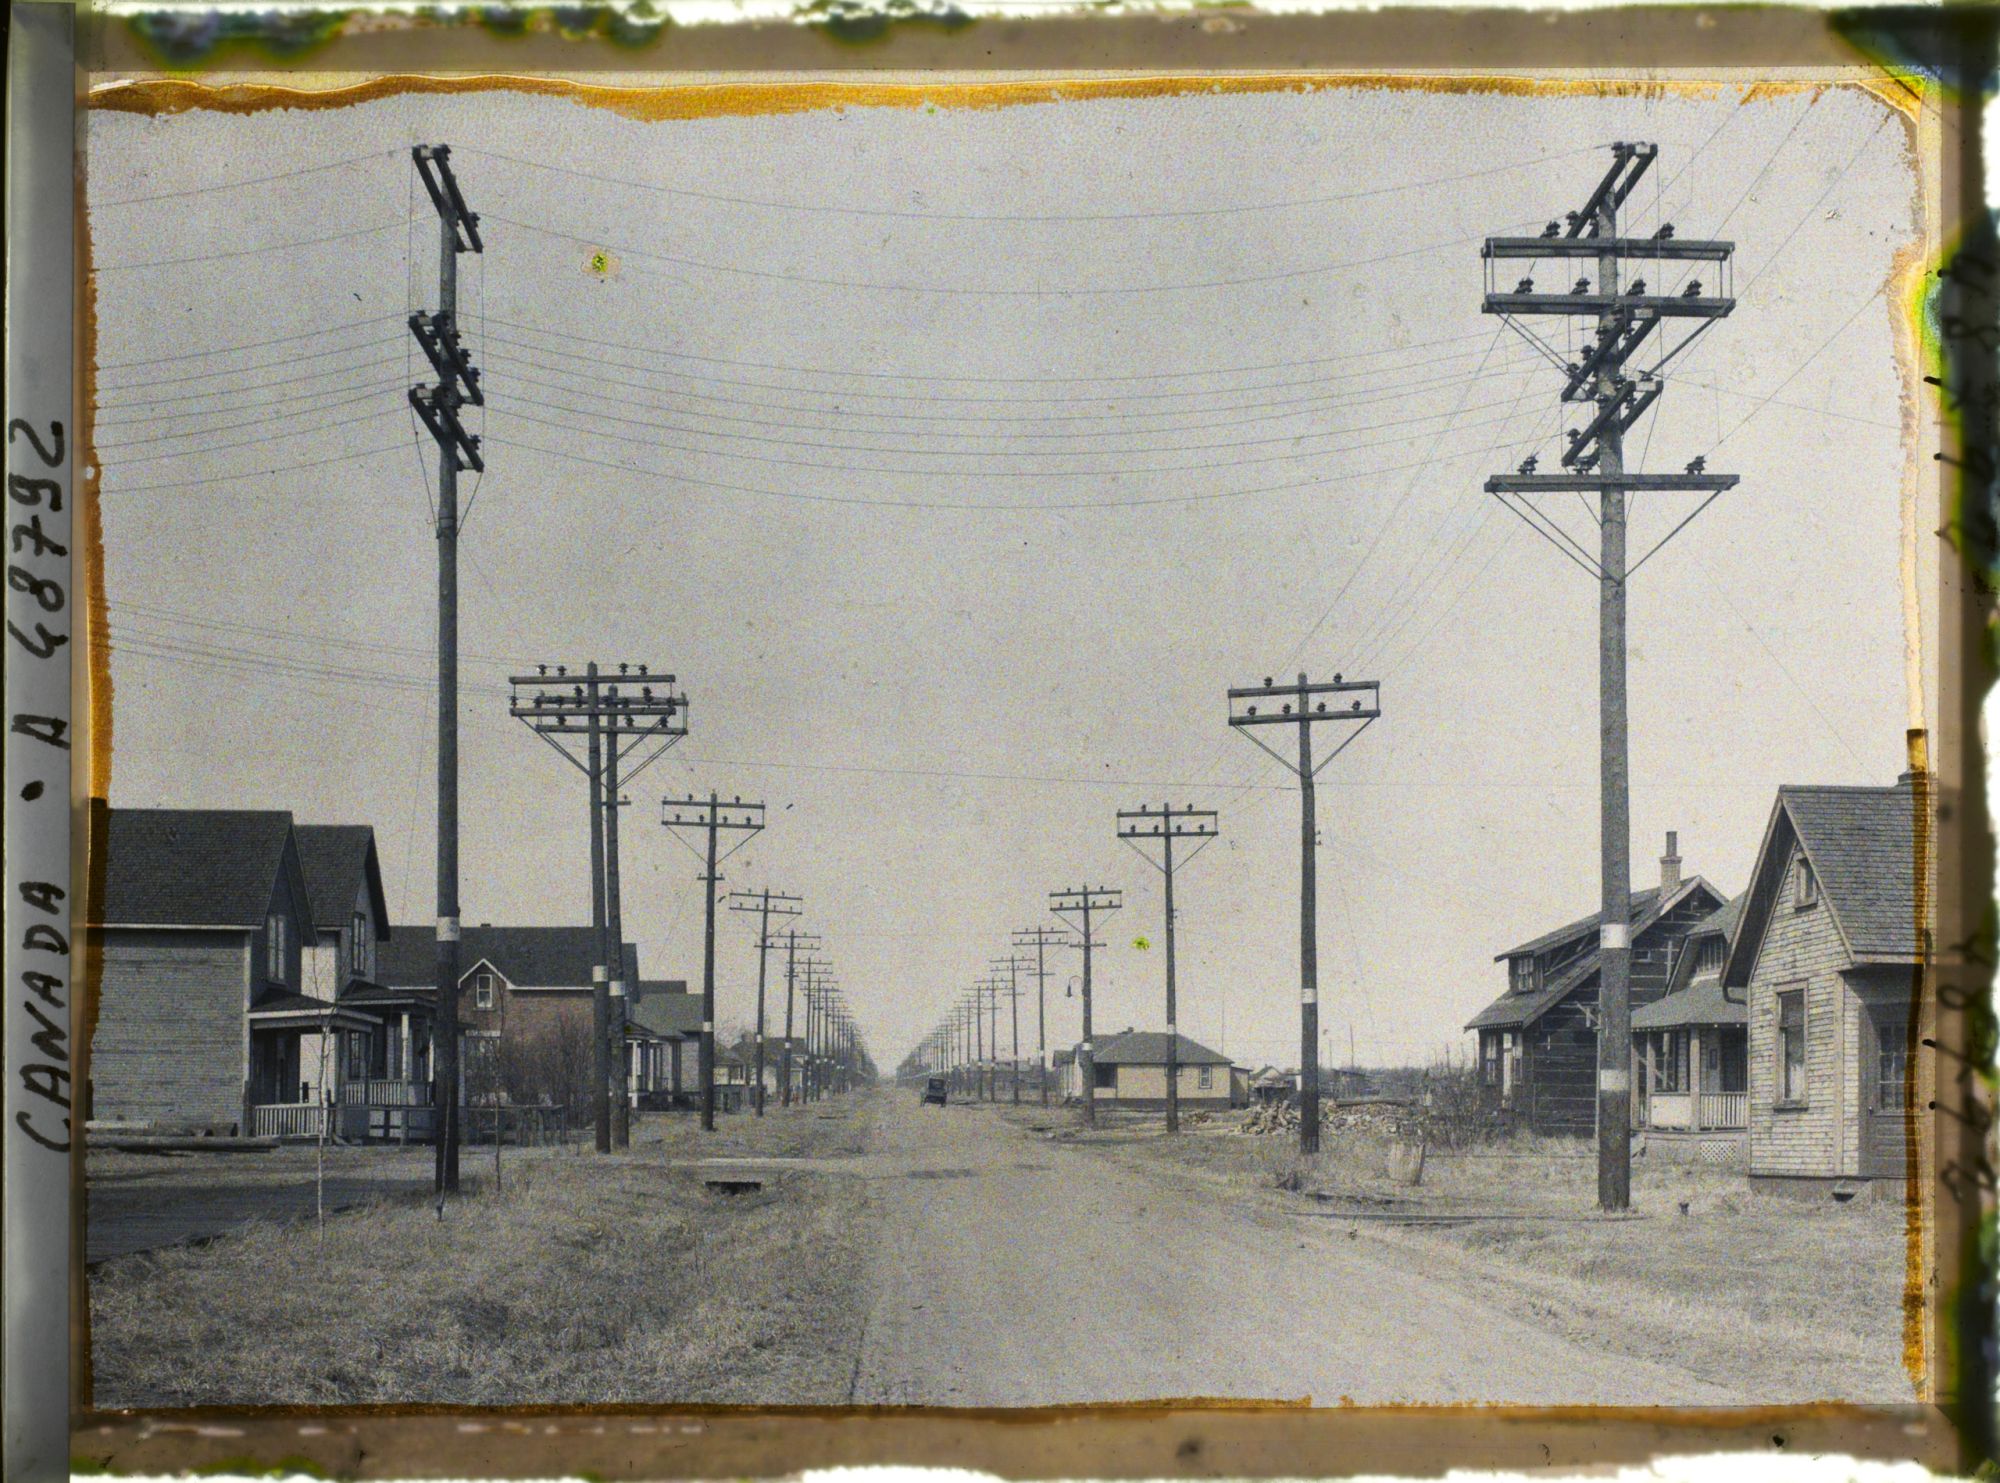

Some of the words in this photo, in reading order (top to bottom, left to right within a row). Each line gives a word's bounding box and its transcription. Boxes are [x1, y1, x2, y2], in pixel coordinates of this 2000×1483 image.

[8, 418, 69, 659] 48792
[11, 713, 70, 751] A
[16, 881, 71, 1153] CANADA
